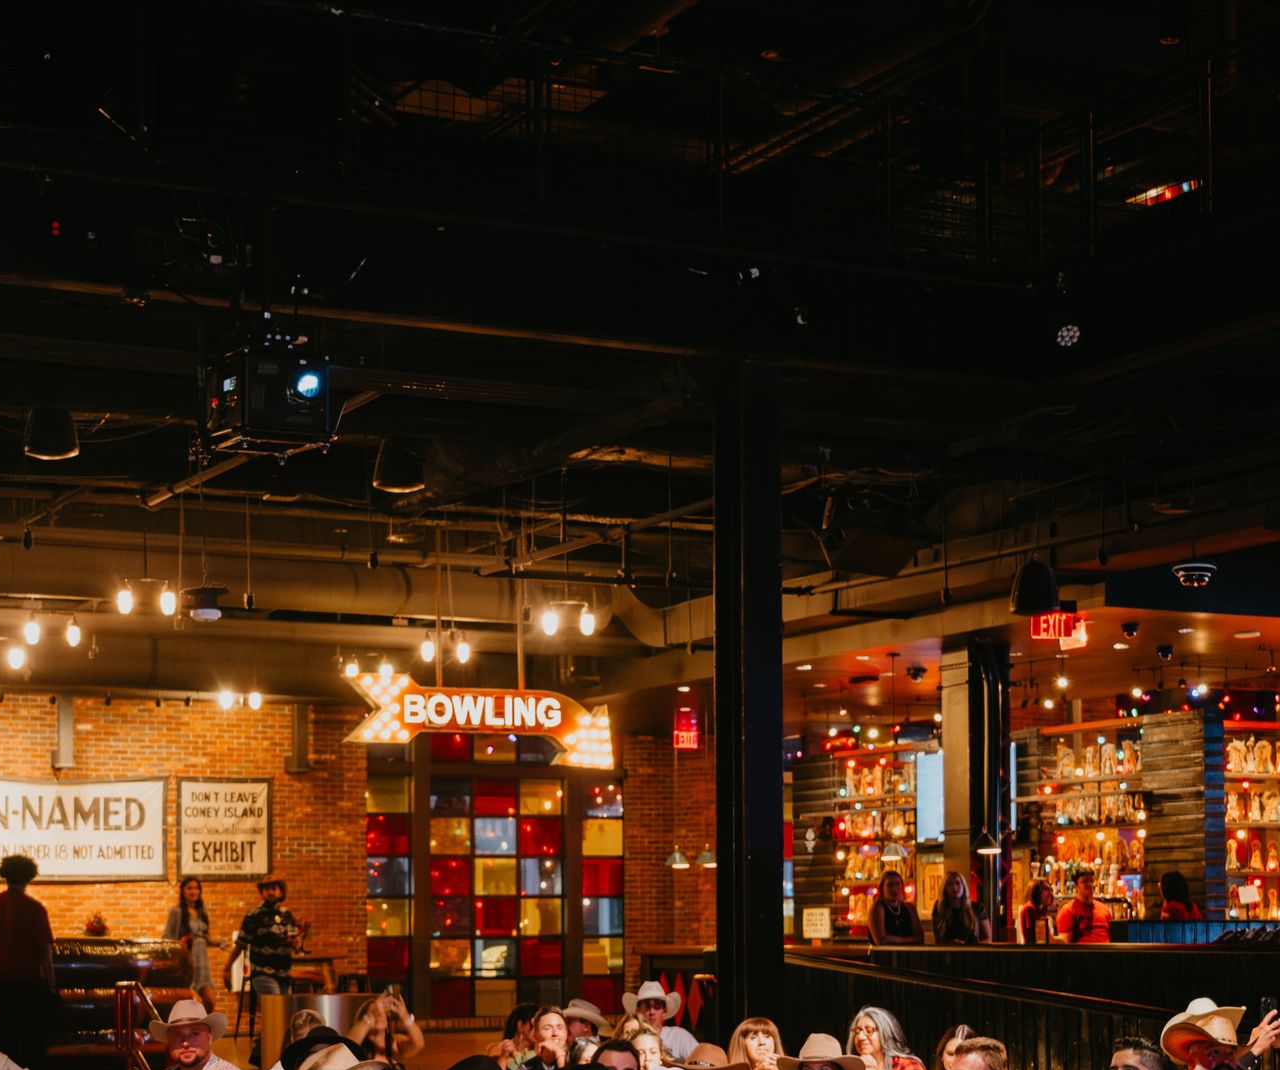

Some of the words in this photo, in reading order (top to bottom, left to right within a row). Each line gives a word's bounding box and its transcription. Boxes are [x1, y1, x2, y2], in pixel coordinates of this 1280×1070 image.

[1040, 614, 1067, 638] EXIT
[404, 693, 562, 728] BOWLING
[191, 791, 220, 802] DONT
[224, 791, 258, 803] LEAVE
[184, 806, 220, 818] CONEY
[224, 807, 263, 818] ISLAND
[14, 843, 50, 860] UNDER
[55, 844, 69, 860] 18
[73, 844, 96, 860] NOT
[97, 844, 155, 860] ADMITTED
[192, 840, 257, 863] EXHIBIT
